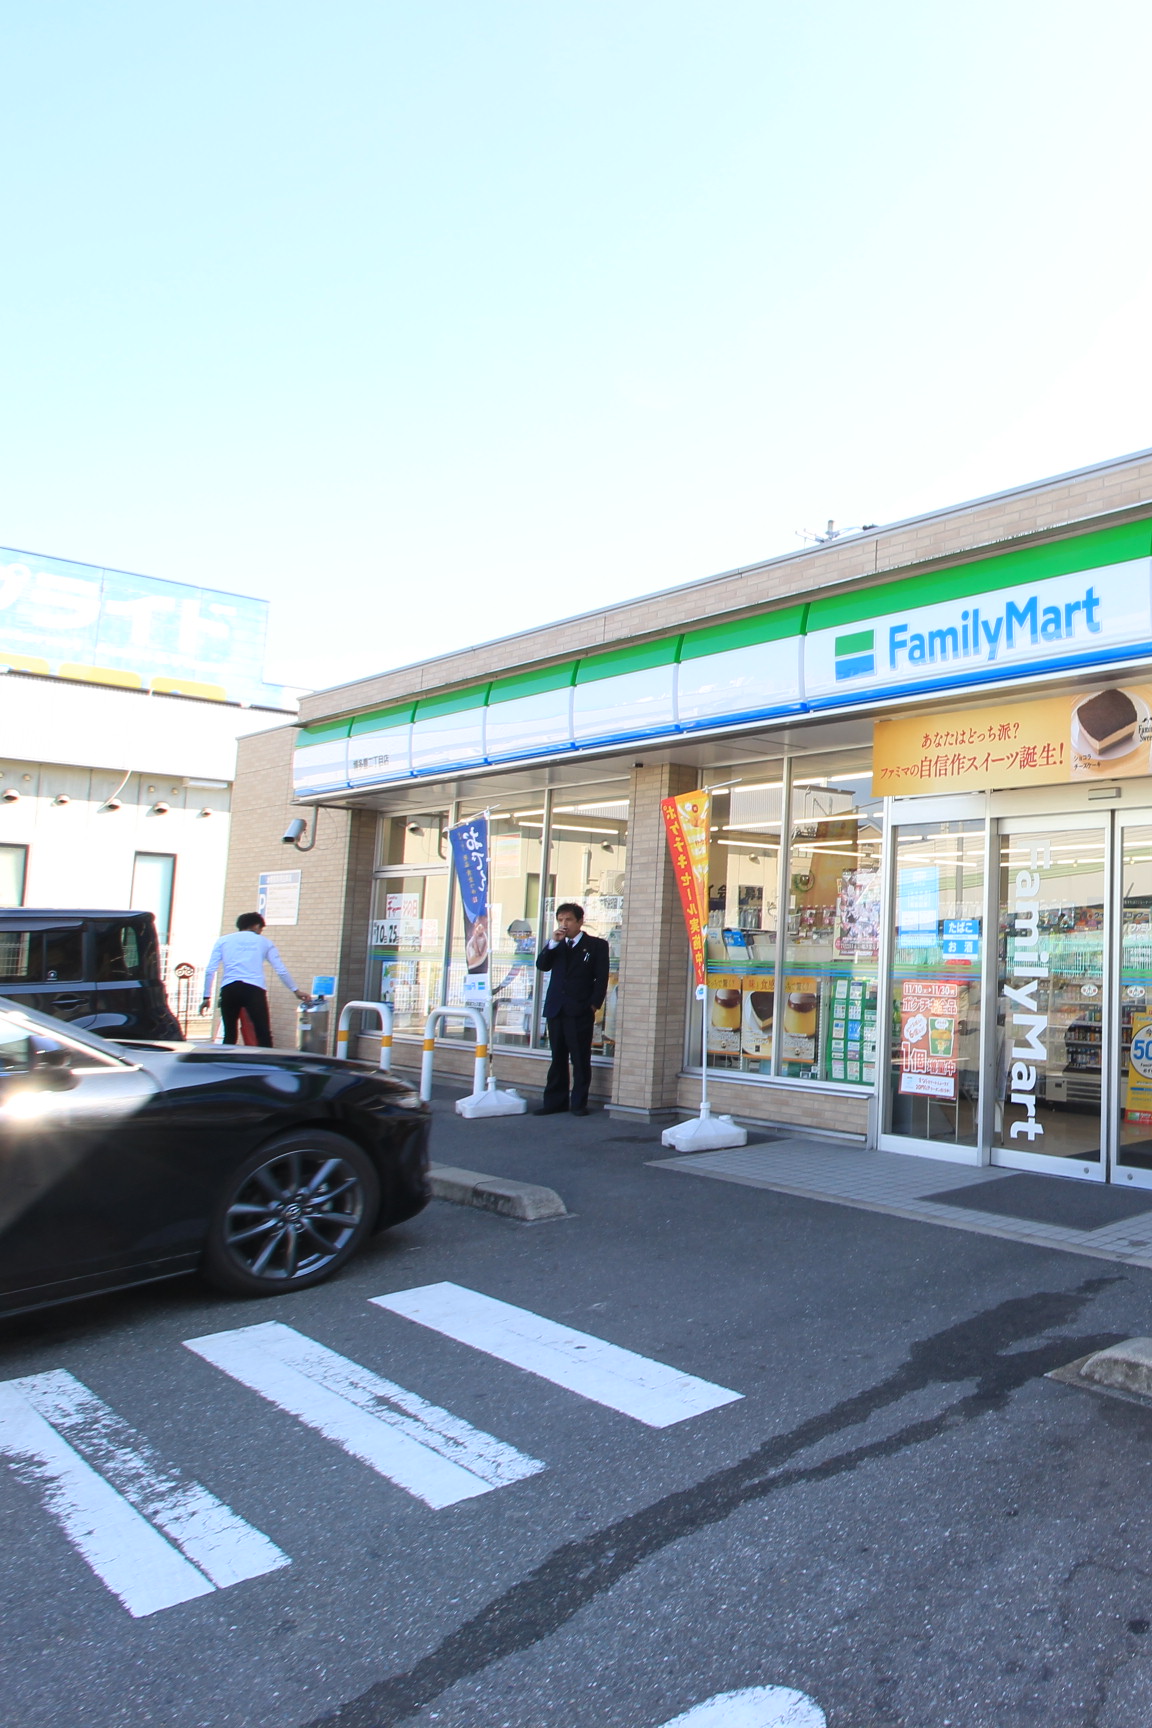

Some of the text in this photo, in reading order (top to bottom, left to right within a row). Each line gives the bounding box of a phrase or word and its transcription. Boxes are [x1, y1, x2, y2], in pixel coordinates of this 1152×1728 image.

[888, 585, 1102, 671] FamilyMart
[921, 722, 1020, 749] あなたはどっち派?
[880, 742, 1065, 780] ファミマの自信作スイーツ誕生!
[948, 921, 973, 934] たばこ
[947, 940, 973, 953] お酒
[1003, 840, 1050, 1141] FamilyMart
